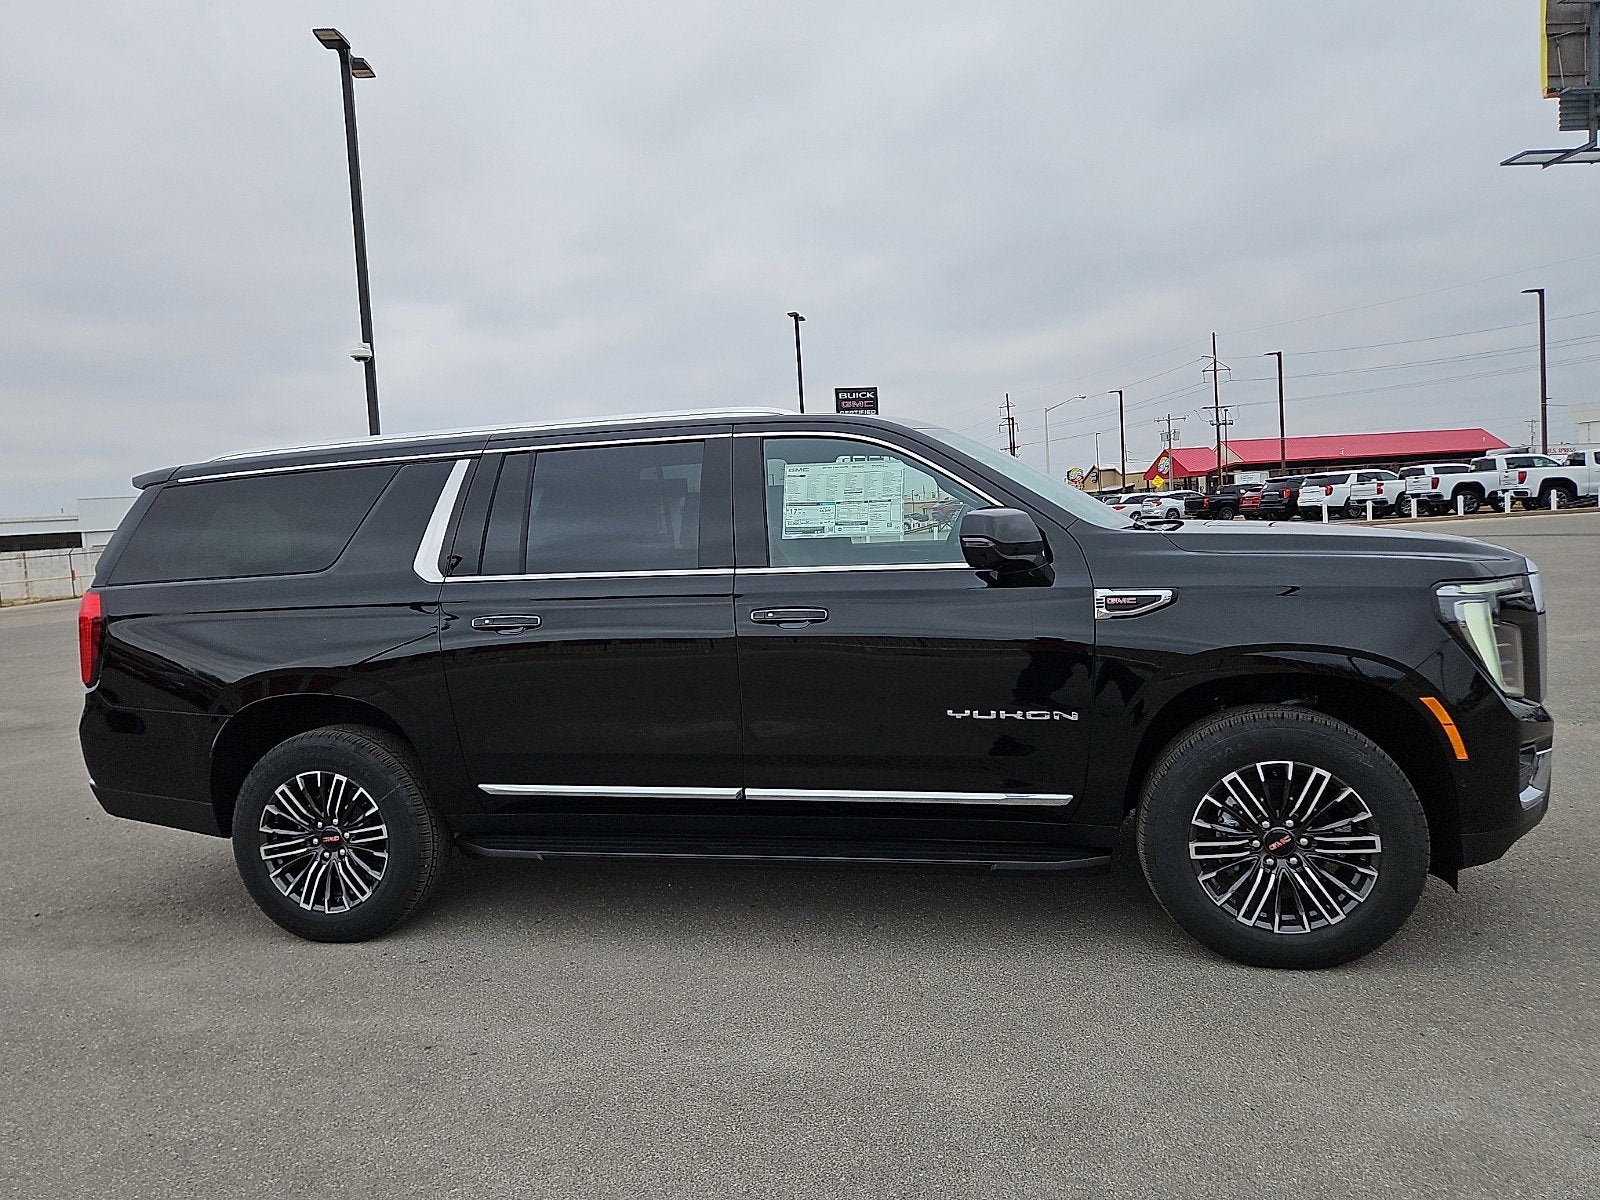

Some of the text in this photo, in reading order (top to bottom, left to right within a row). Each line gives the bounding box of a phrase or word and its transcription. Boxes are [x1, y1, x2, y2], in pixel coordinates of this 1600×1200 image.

[841, 400, 874, 408] GMC
[1106, 597, 1137, 605] GMC
[946, 709, 1079, 721] YUKON
[1268, 834, 1292, 851] GMC
